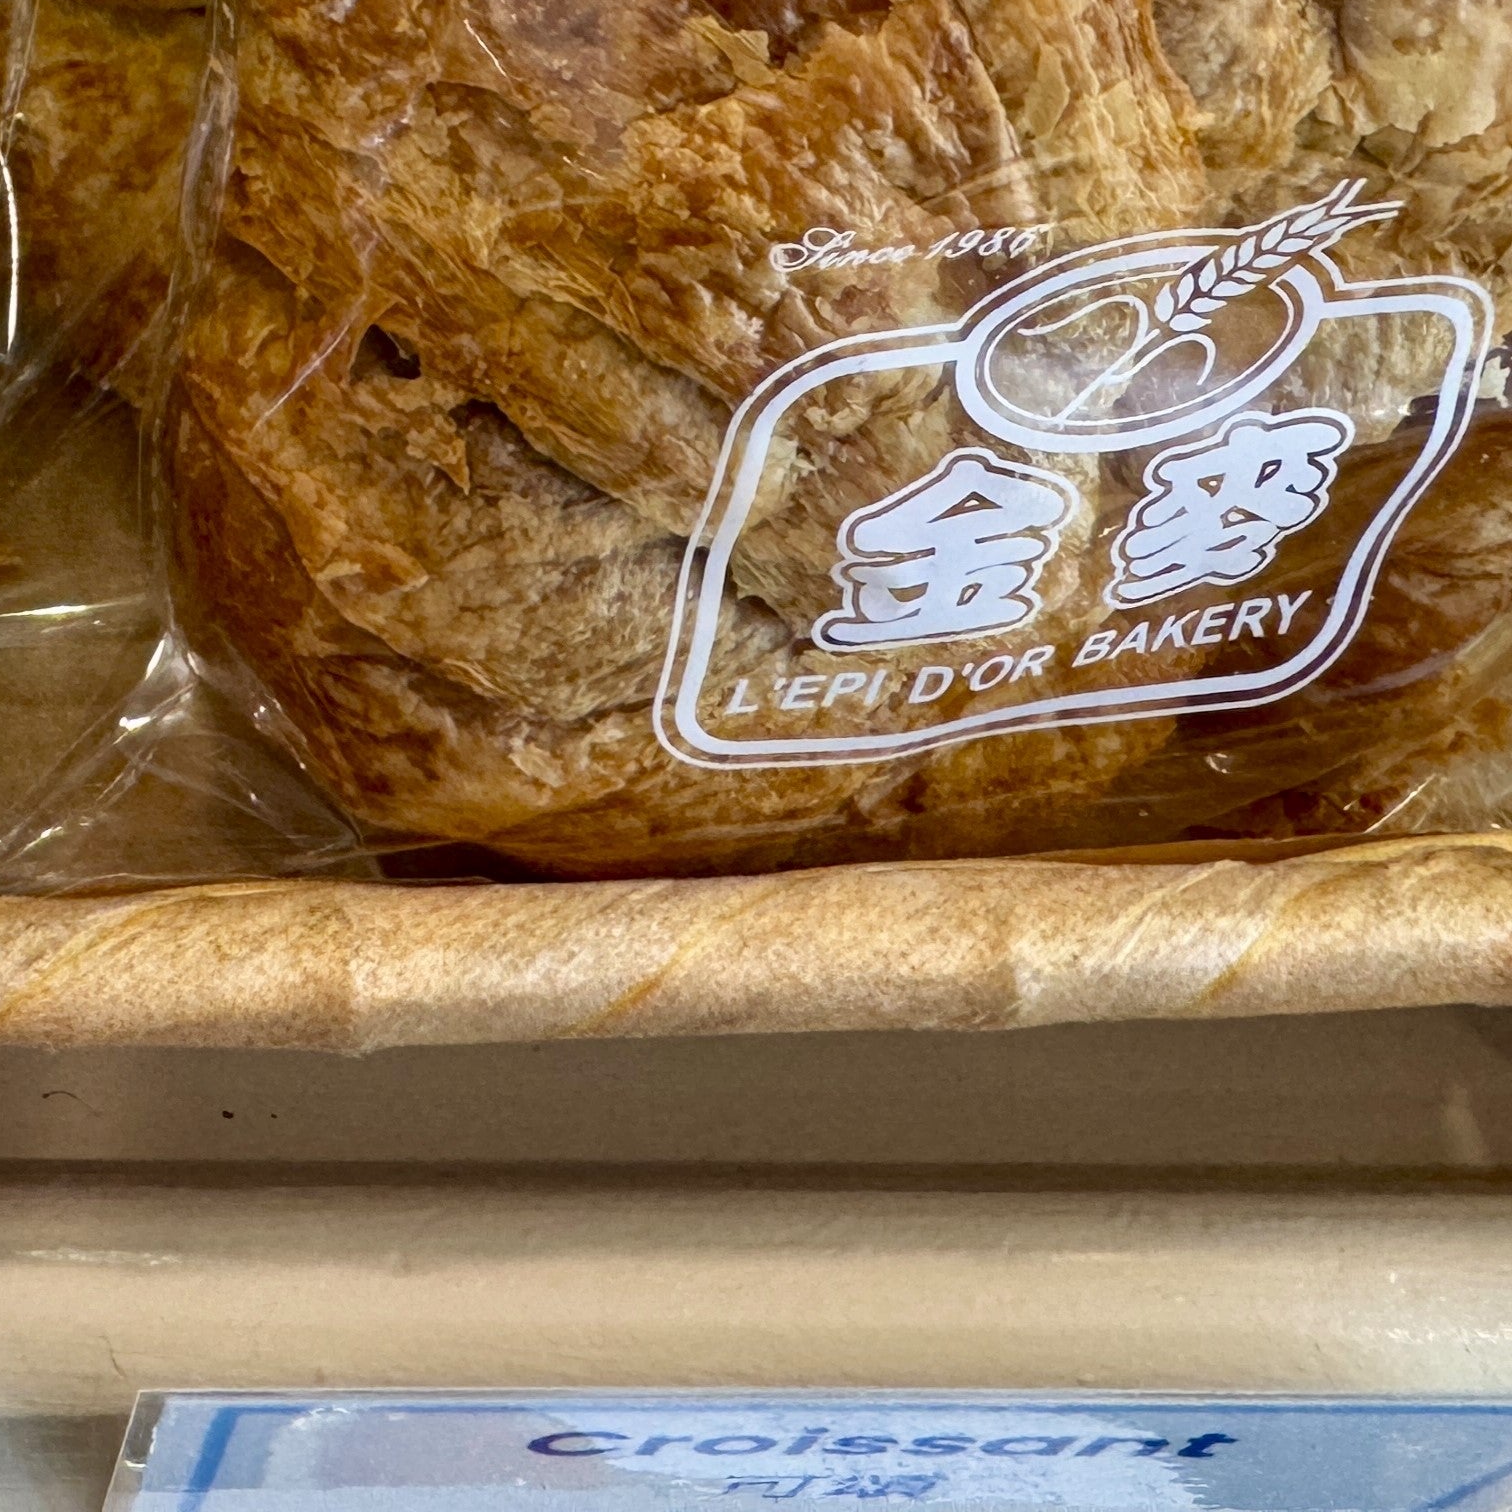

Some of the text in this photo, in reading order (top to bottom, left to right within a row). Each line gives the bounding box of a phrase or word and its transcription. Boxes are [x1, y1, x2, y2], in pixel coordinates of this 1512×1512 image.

[769, 222, 1055, 273] Since 1986
[725, 589, 1314, 716] L'EPI D'OR BAKERY
[527, 1427, 1240, 1459] Croissant
